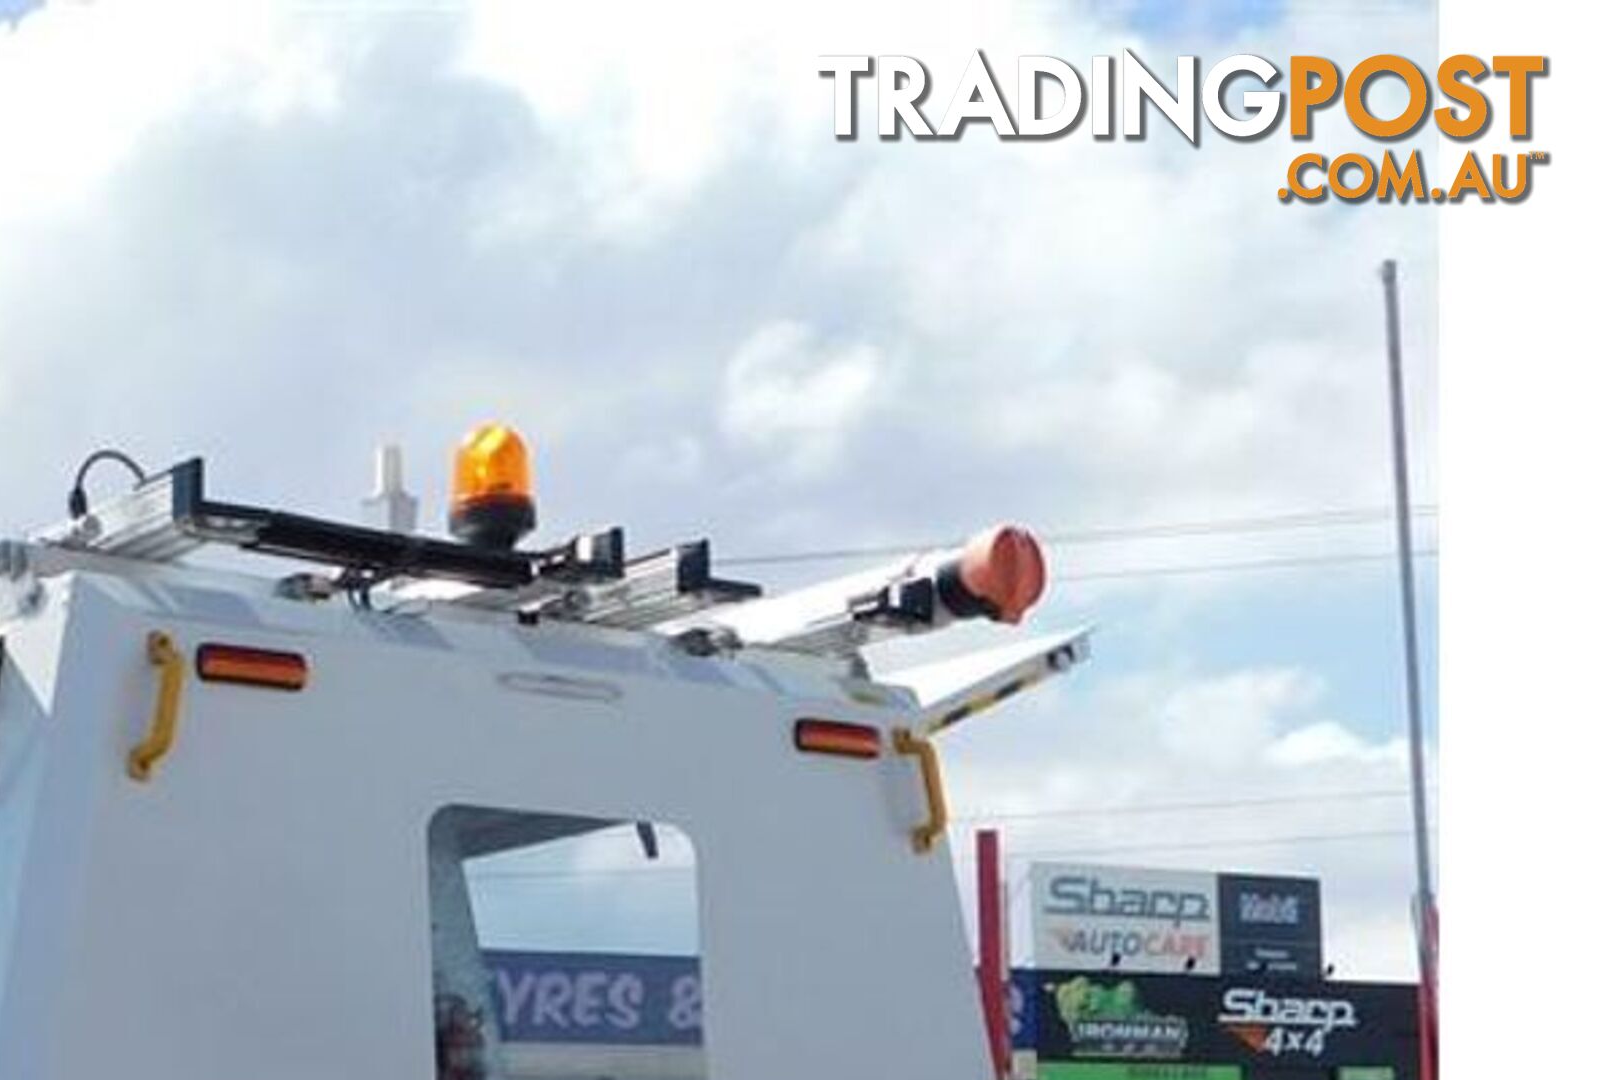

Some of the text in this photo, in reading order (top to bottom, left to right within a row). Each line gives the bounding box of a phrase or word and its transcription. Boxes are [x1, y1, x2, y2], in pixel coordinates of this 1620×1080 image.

[1045, 875, 1210, 927] Sharp
[1218, 988, 1359, 1032] Sharp
[1265, 1027, 1325, 1057] 4x4
